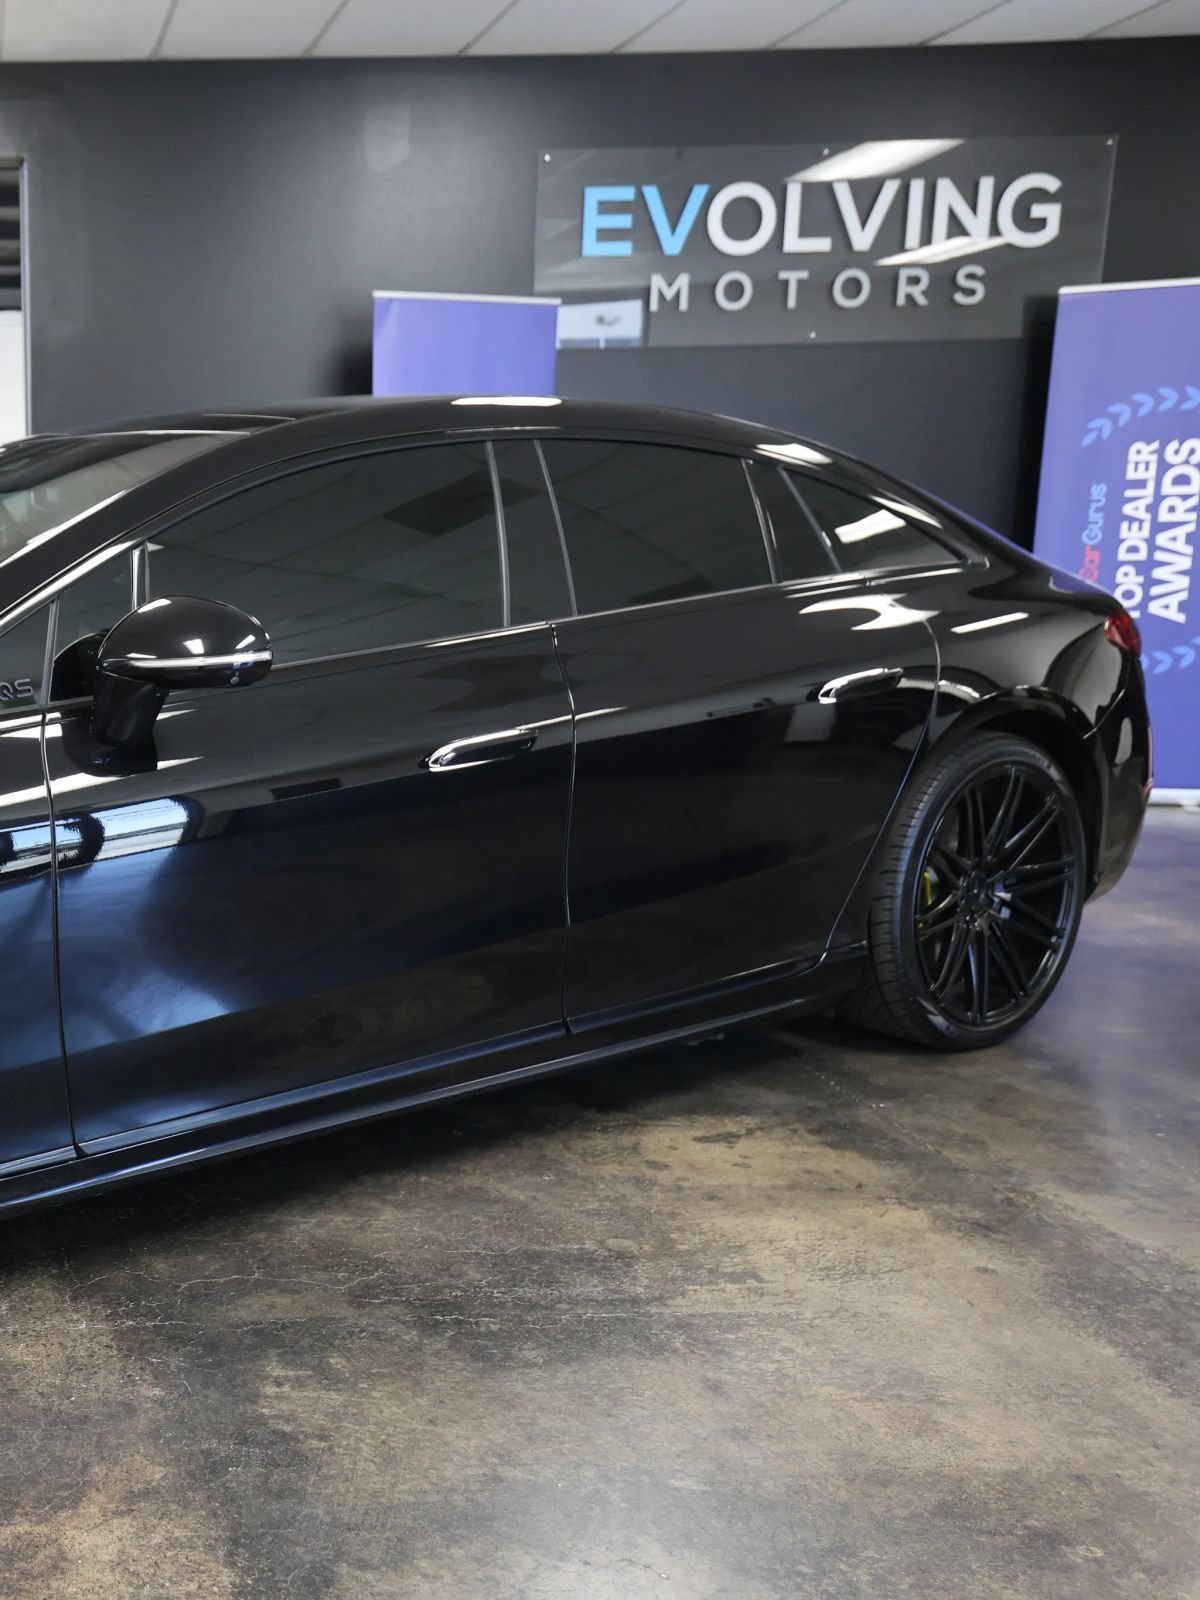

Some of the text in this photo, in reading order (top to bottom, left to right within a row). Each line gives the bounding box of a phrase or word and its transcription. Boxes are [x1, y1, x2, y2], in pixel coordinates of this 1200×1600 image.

[581, 172, 1062, 257] EVOLVING
[649, 265, 986, 312] MOTORS
[1113, 440, 1160, 619] OP DEALER
[1147, 437, 1200, 624] AWARDS
